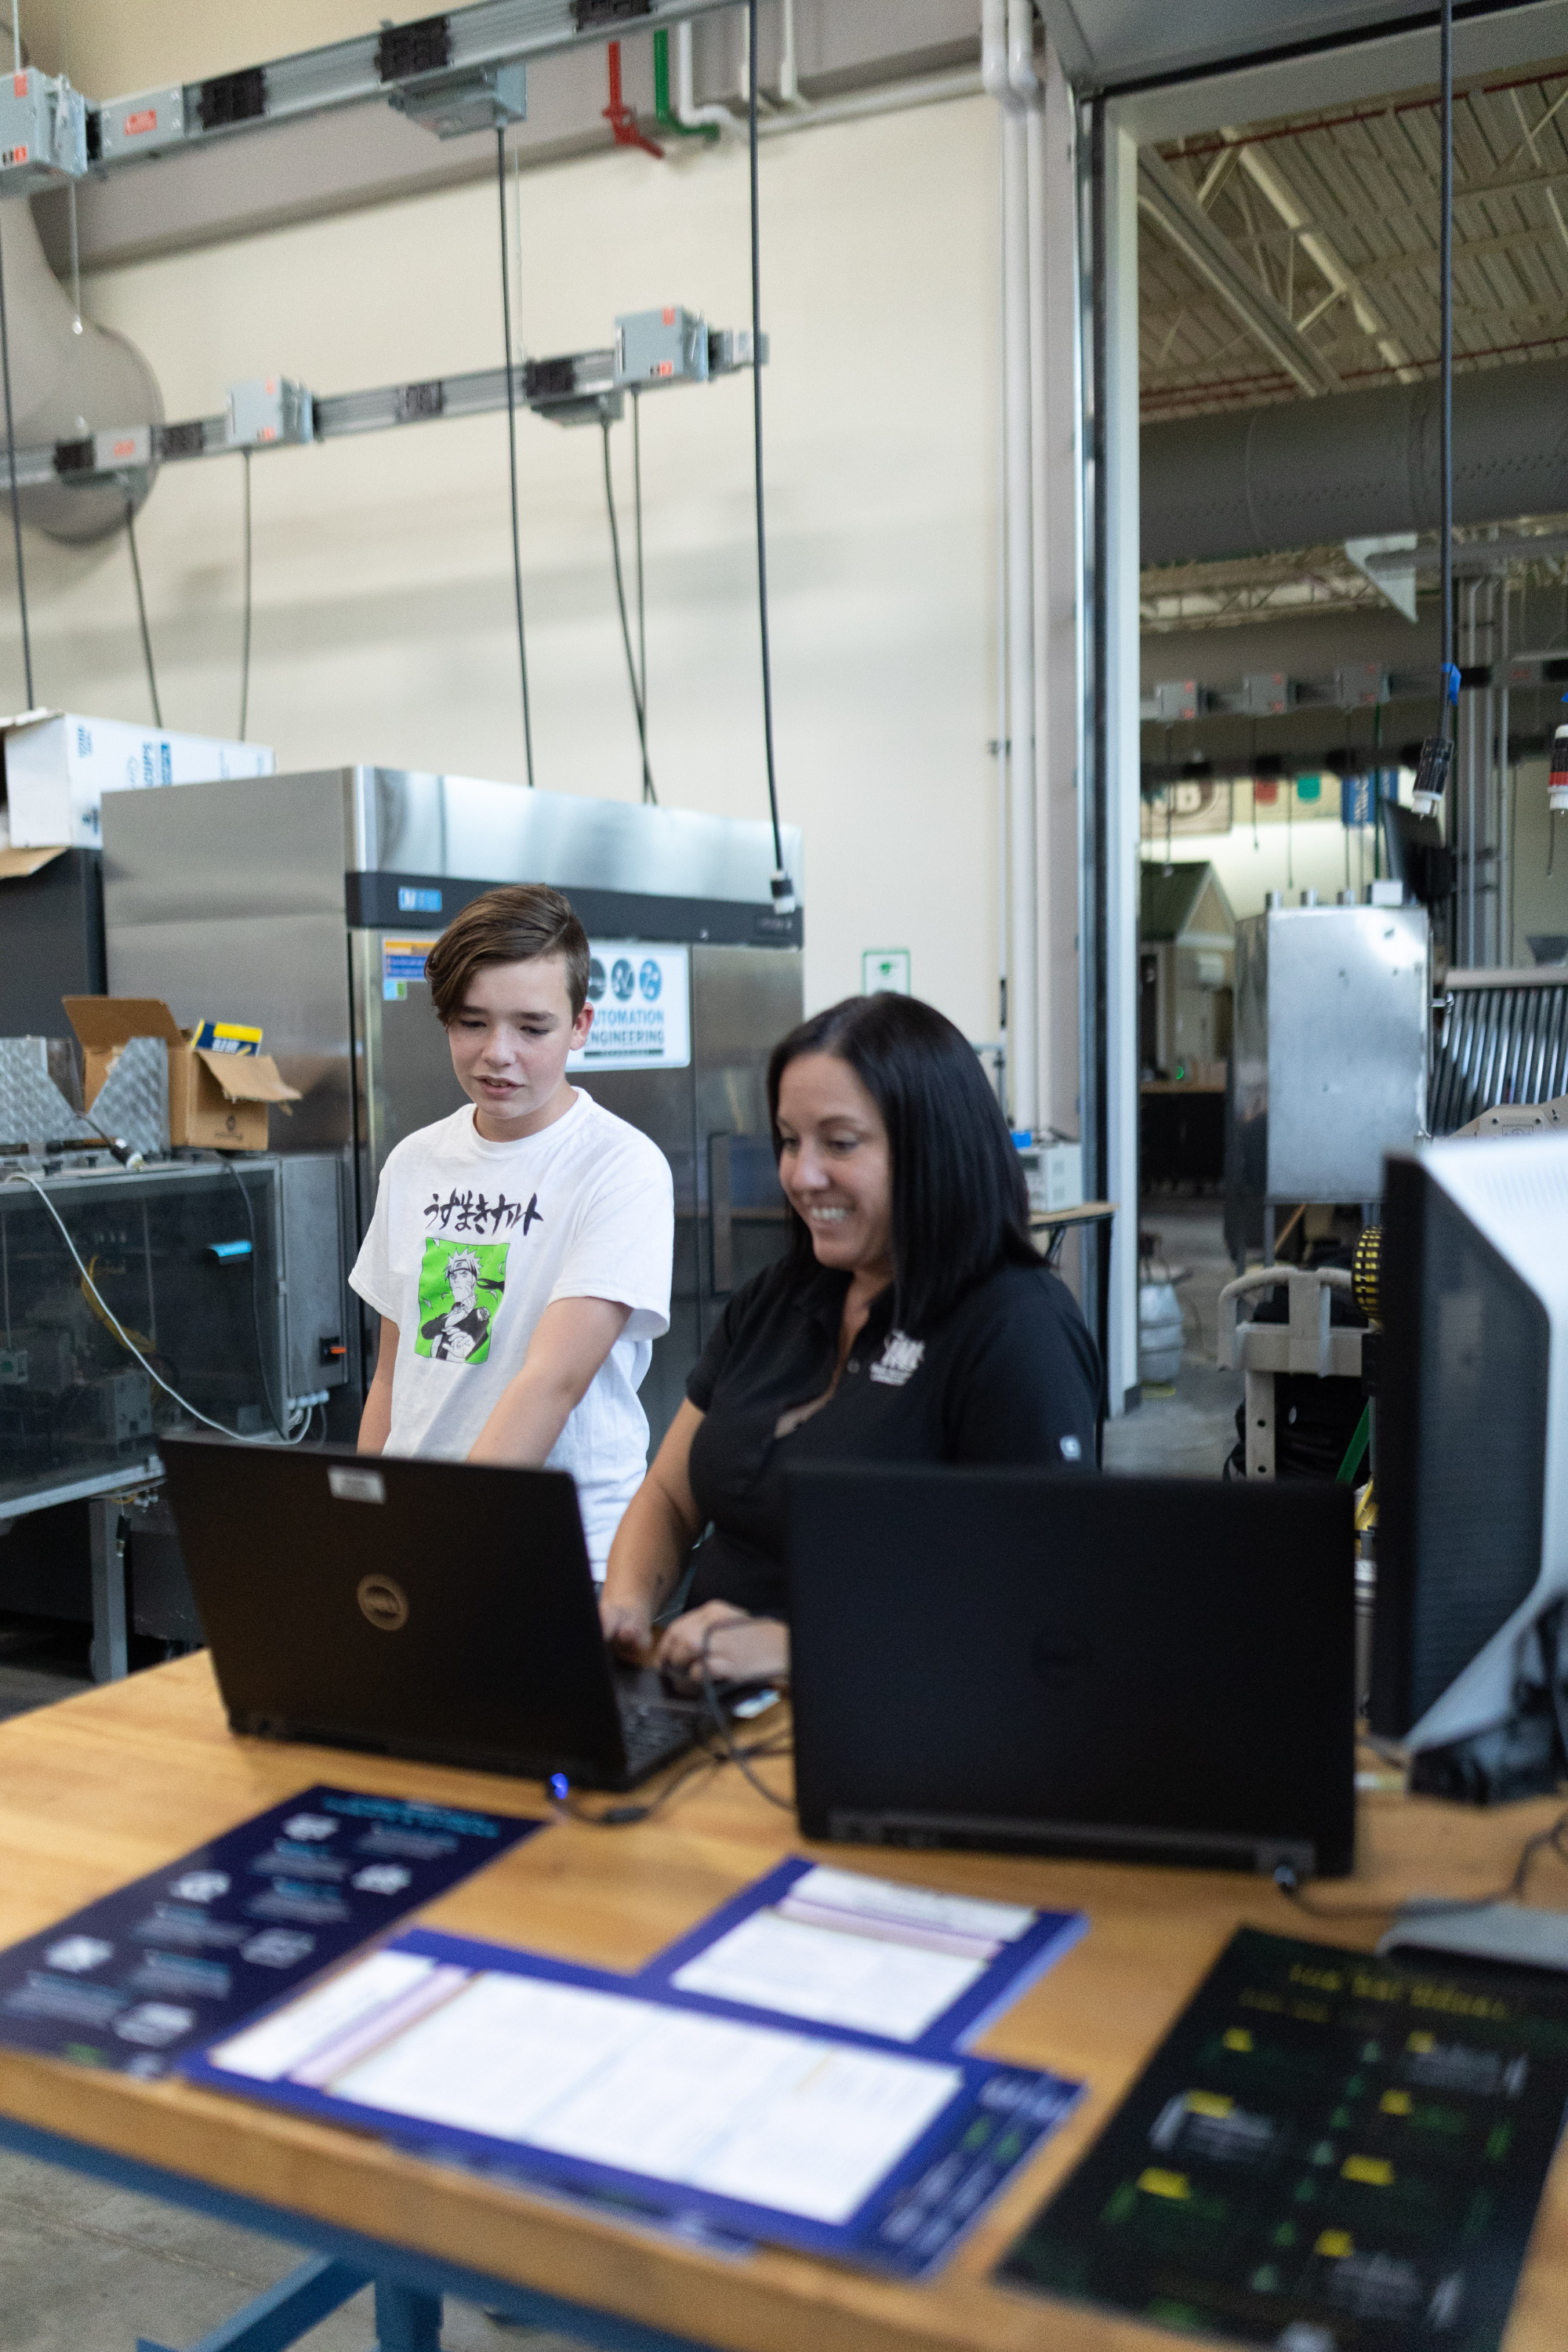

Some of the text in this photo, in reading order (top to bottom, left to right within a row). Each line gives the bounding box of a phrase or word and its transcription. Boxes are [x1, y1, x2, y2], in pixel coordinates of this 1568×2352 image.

[590, 1008, 665, 1026] UTOMATION
[423, 1188, 544, 1236] うずまきナルト
